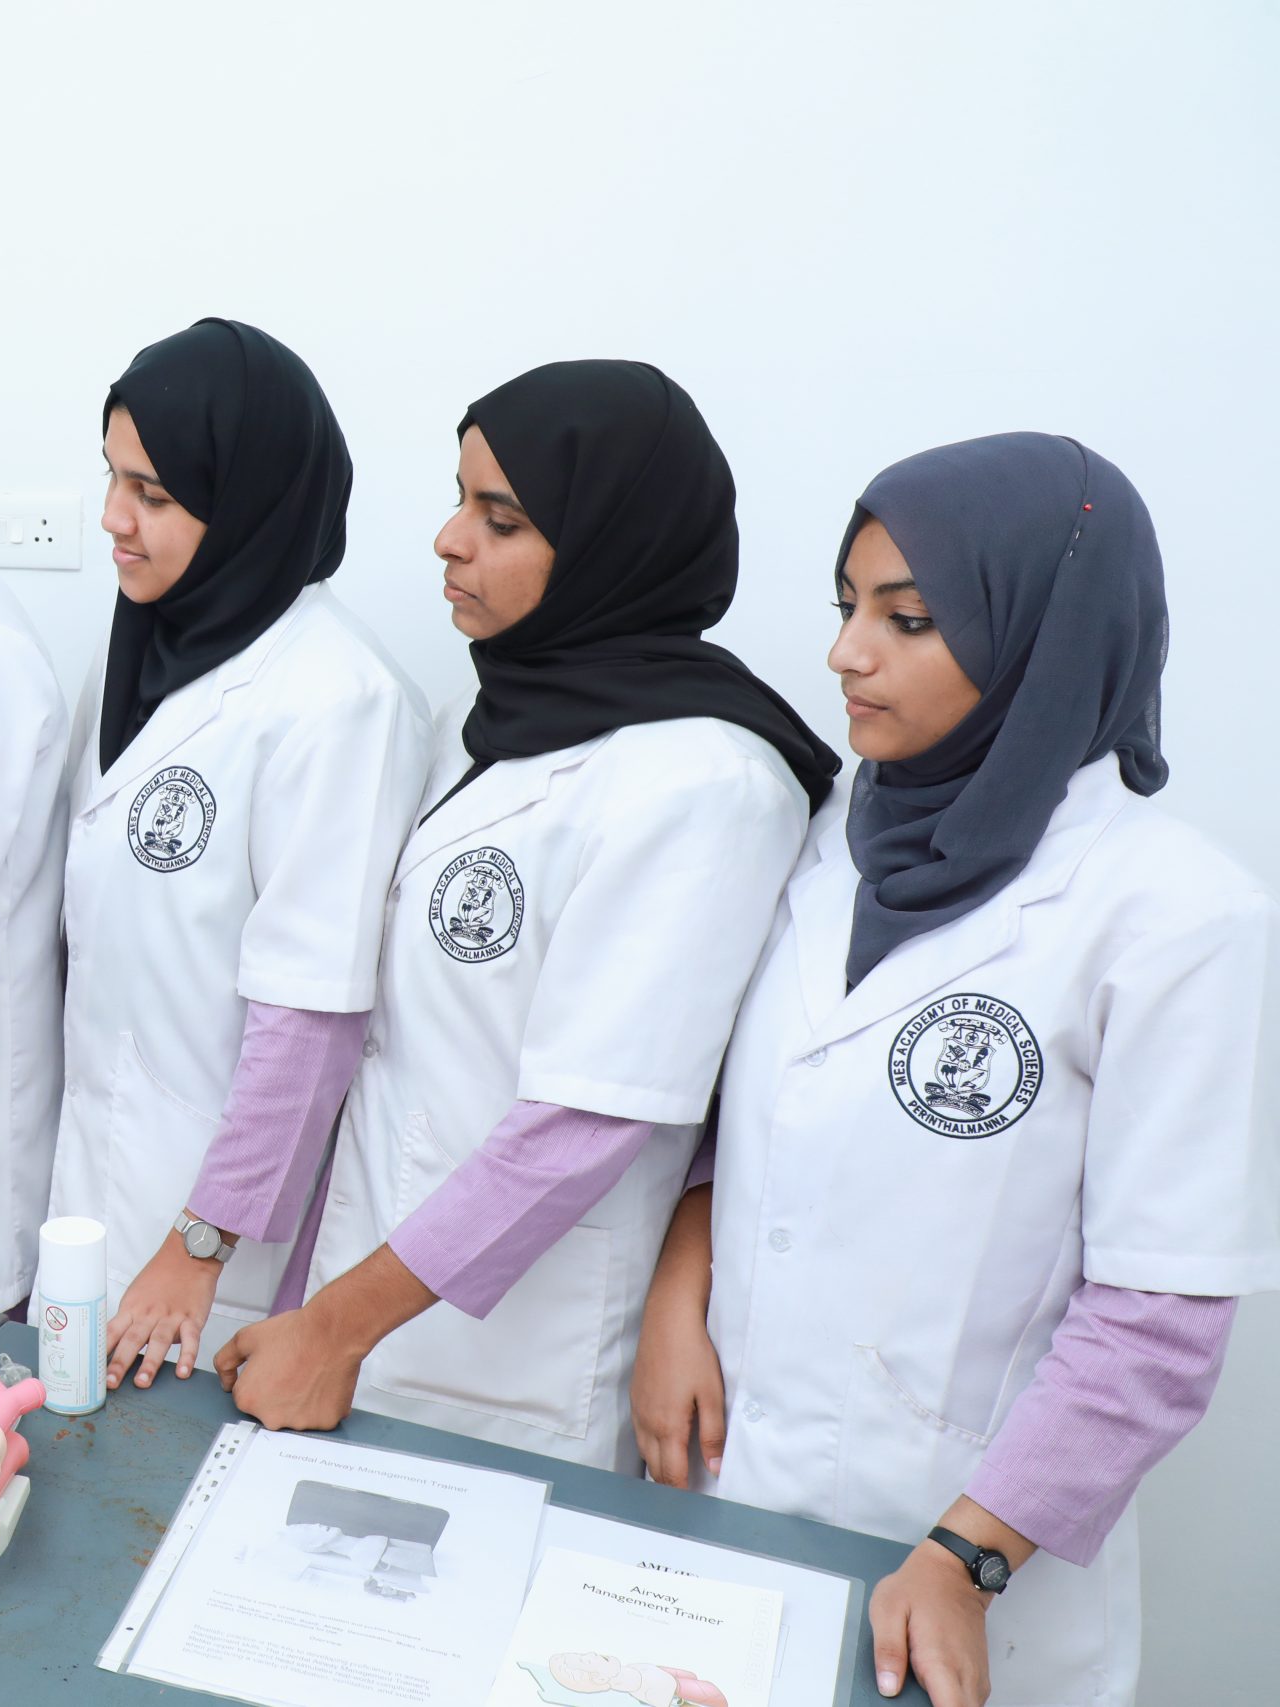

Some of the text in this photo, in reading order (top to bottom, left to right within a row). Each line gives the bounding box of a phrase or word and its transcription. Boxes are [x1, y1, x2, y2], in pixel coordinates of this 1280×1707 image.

[134, 774, 165, 814] ACADEMY
[168, 770, 178, 779] OF
[180, 770, 208, 800] MEDICAL
[198, 802, 214, 850] SCIENCES
[432, 850, 522, 939] MES ACADEMY OF MEDICAL SCIENCES
[438, 931, 504, 960] PERINTHALMANNA
[893, 998, 1038, 1106] MES ACADEMY OF MEDICAL SCIENCES
[908, 1100, 1010, 1134] PERINTHALMANNA
[278, 1450, 470, 1494] Laerdal Airway Management Trainer
[582, 1583, 671, 1614] Management
[673, 1606, 725, 1626] Trainer
[630, 1586, 679, 1605] Airway
